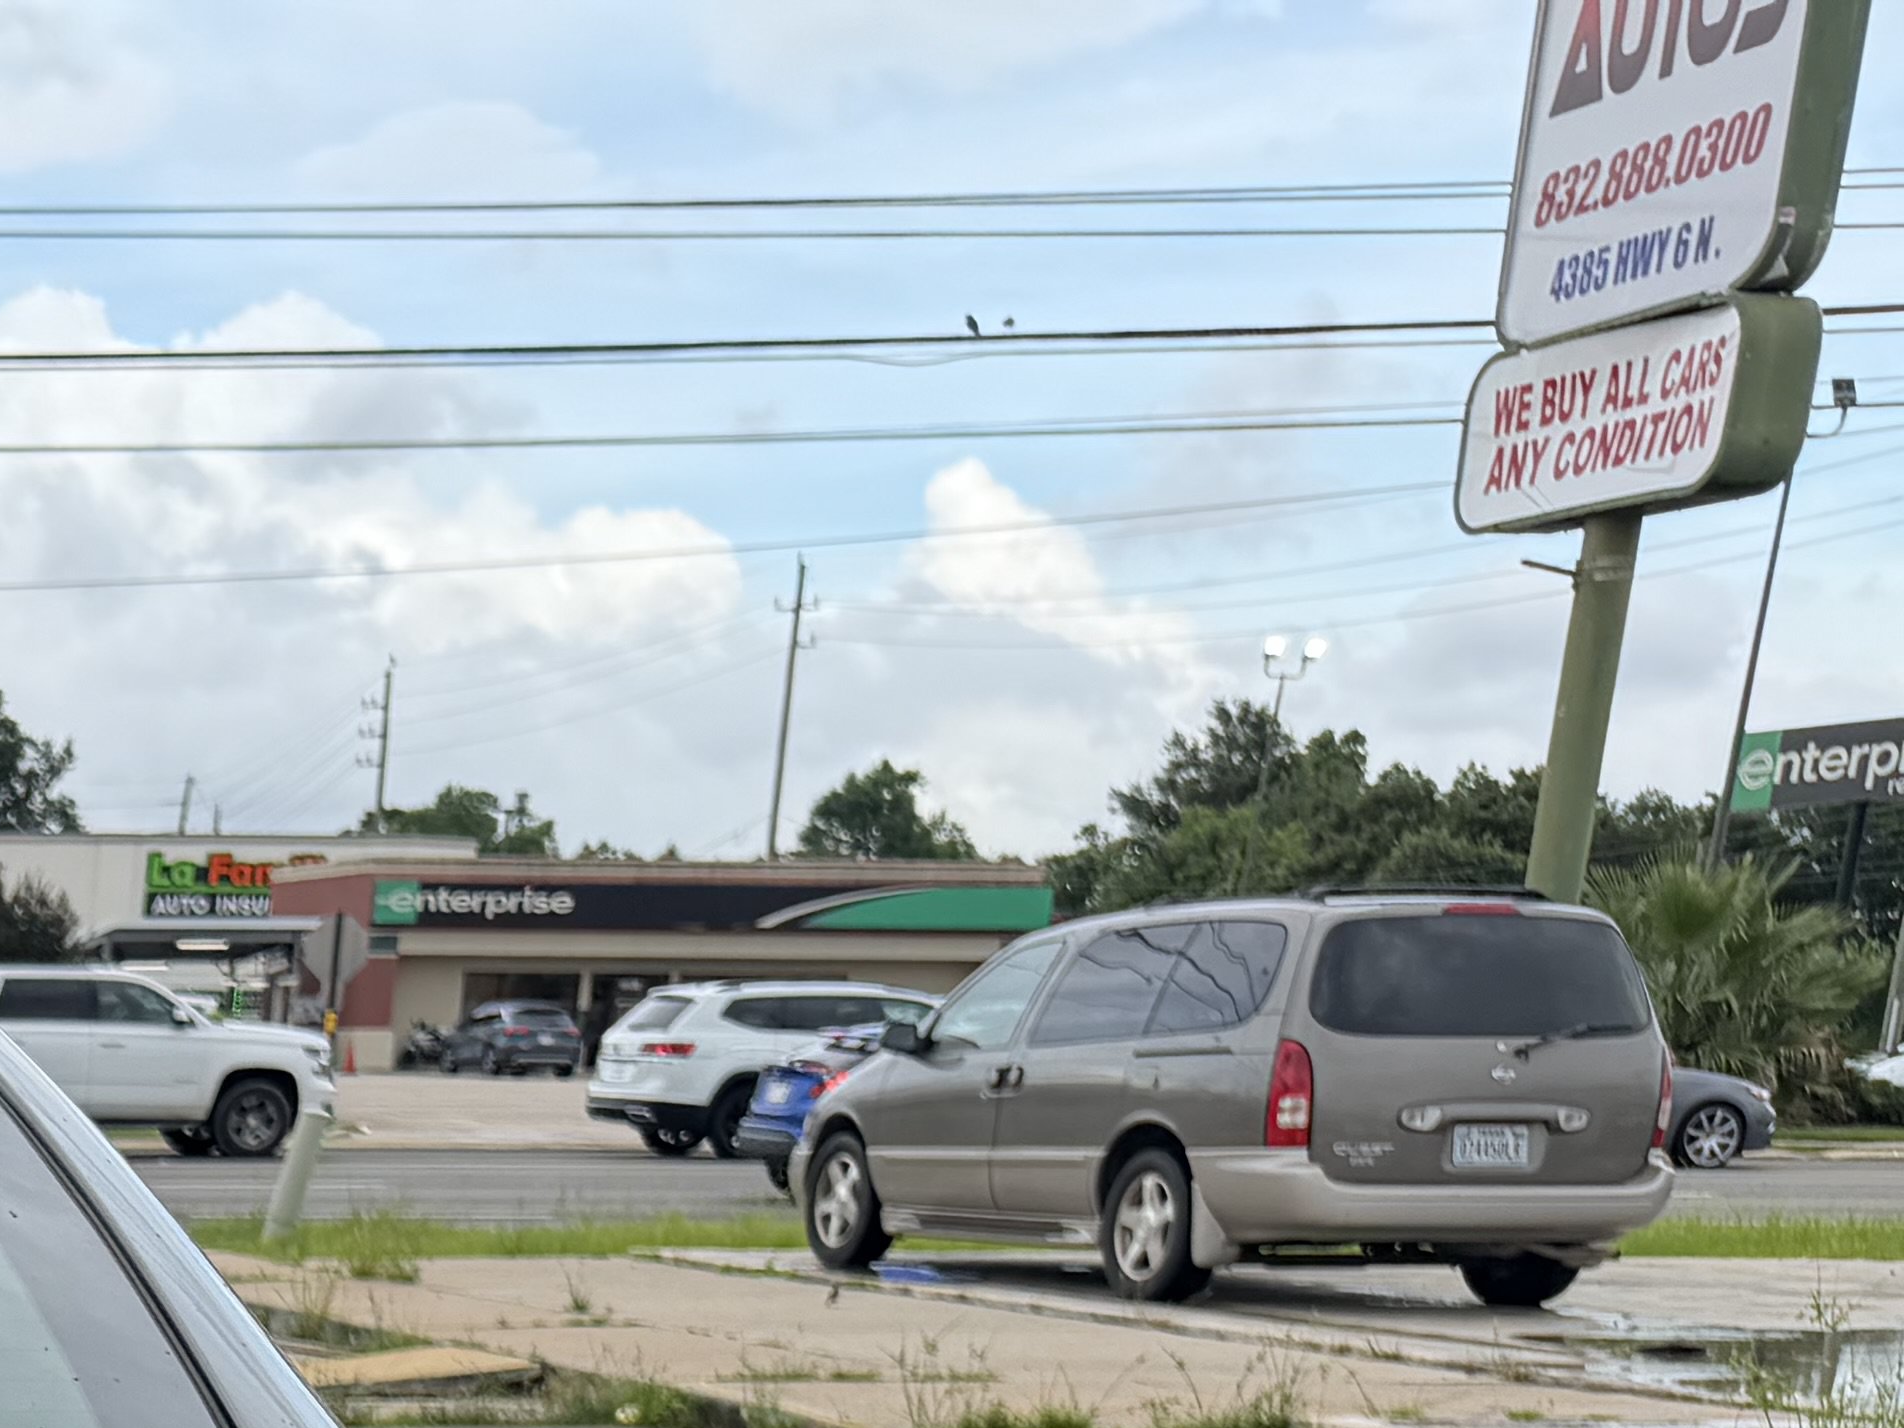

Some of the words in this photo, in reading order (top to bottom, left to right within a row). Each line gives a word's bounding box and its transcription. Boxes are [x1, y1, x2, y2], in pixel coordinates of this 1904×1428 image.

[1534, 102, 1773, 229] 832.888.0300
[1550, 245, 1611, 303] 4385
[1612, 226, 1672, 286] HWY
[1672, 221, 1692, 271] 6
[1694, 215, 1721, 264] N.
[1494, 382, 1534, 439] WE
[1539, 367, 1597, 428] BUY
[1600, 355, 1651, 415] ALL
[1660, 335, 1727, 401] CARS
[1483, 435, 1551, 496] ANY
[1553, 396, 1715, 482] CONDITION
[148, 852, 197, 888] La
[150, 893, 212, 917] AUTO
[376, 885, 576, 920] enterprise
